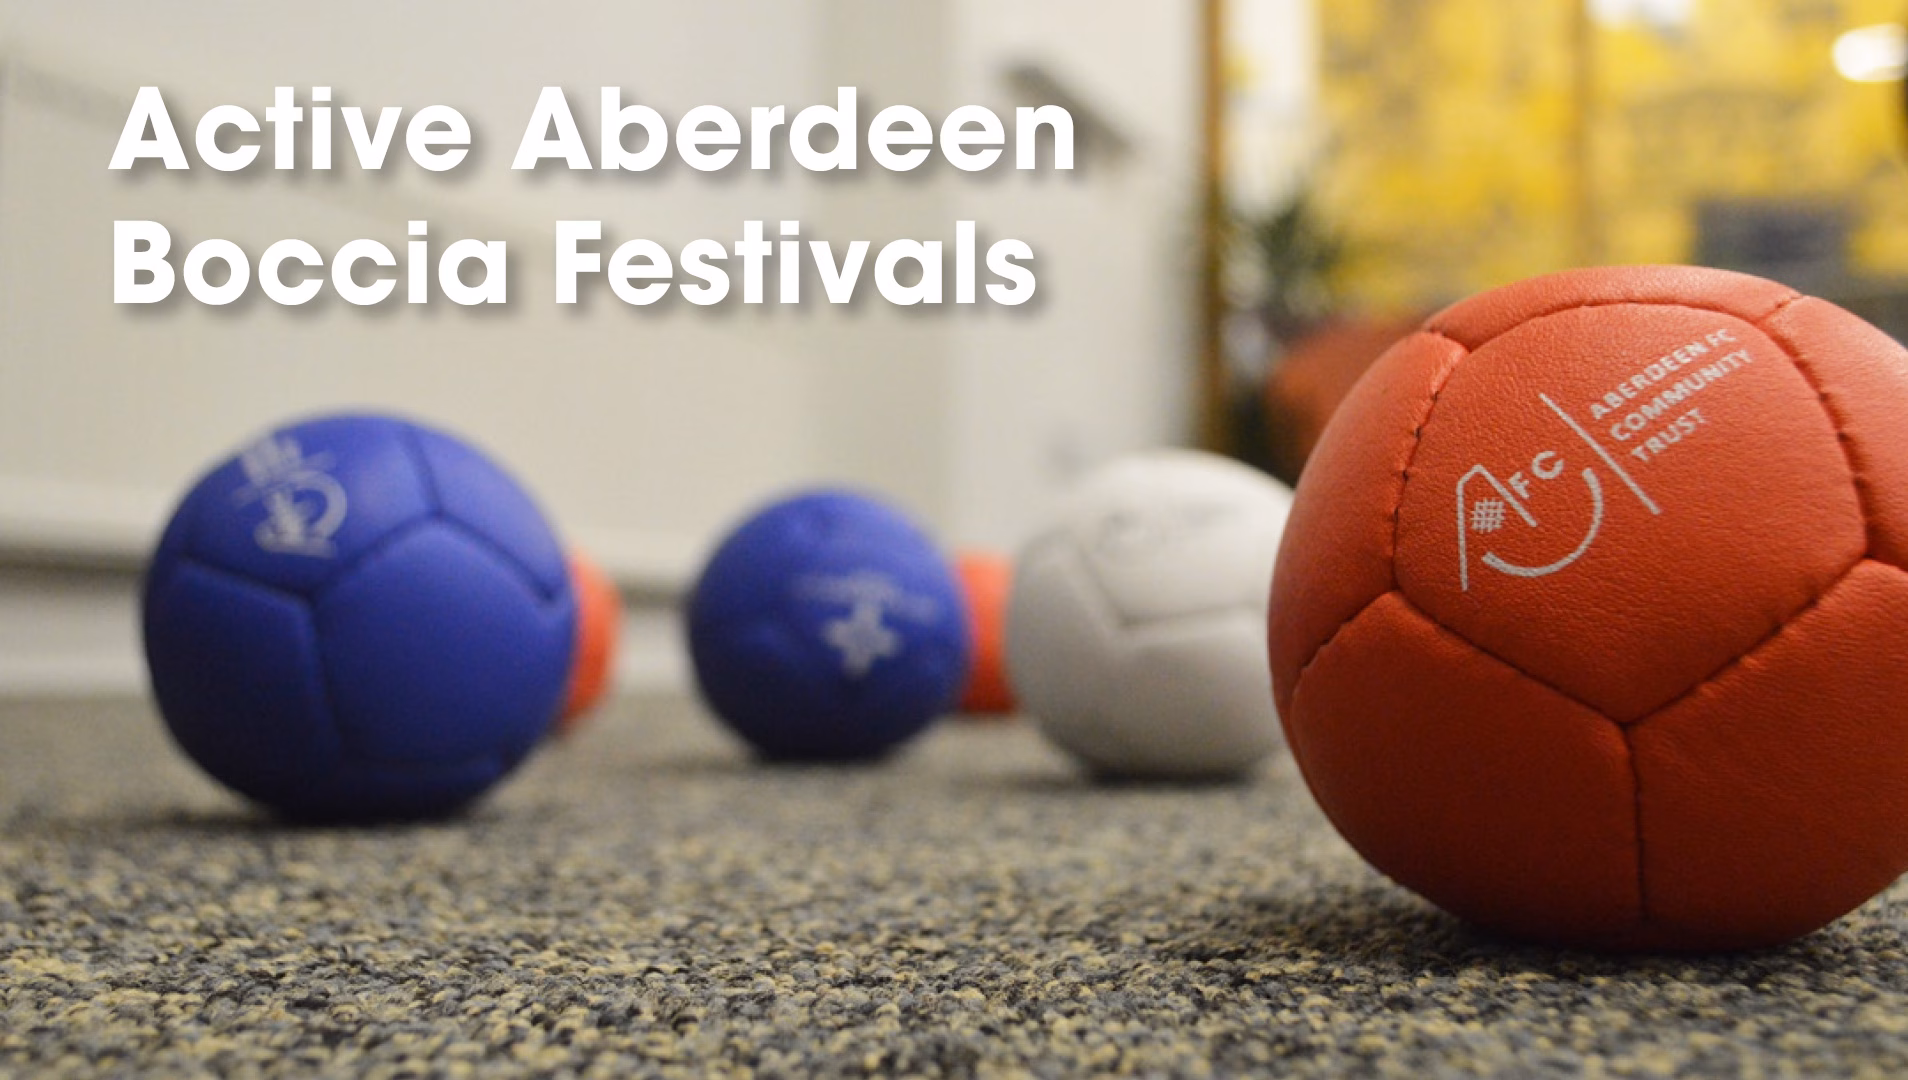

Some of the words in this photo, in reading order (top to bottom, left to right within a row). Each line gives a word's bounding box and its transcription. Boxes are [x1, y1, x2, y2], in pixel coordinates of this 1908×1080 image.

[1590, 341, 1709, 419] ABERDEEN
[1705, 328, 1736, 347] FC
[1610, 349, 1753, 441] COMMUNITY
[1631, 407, 1707, 462] TRUST
